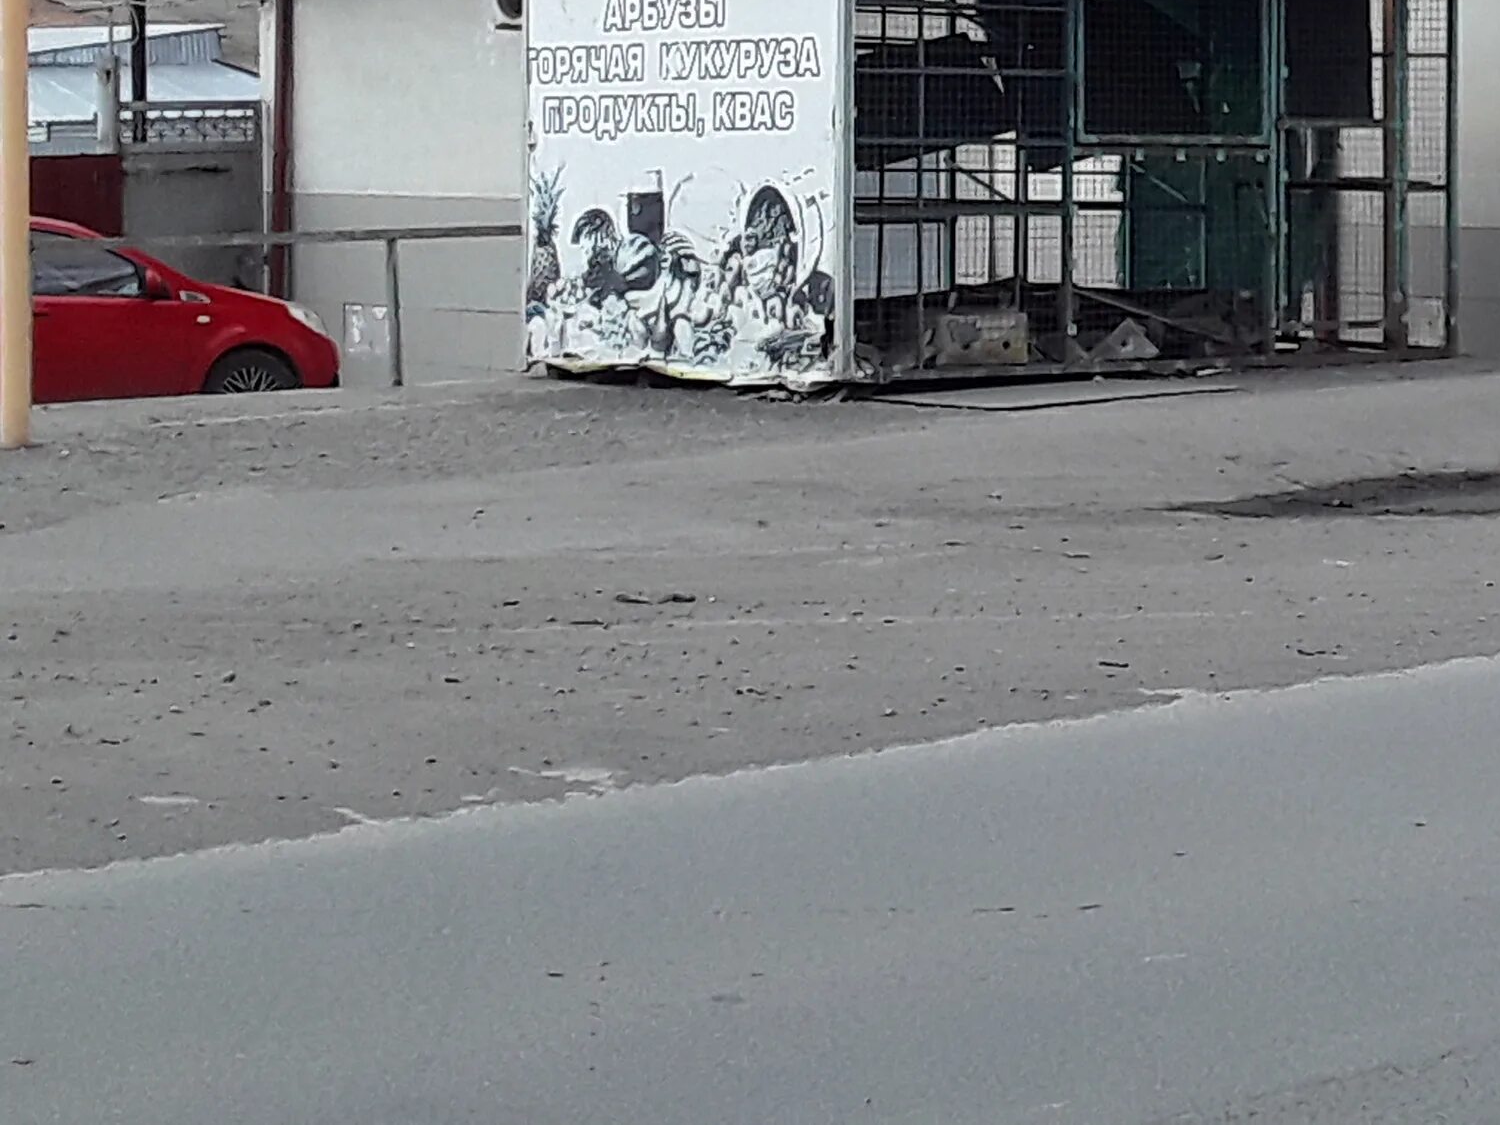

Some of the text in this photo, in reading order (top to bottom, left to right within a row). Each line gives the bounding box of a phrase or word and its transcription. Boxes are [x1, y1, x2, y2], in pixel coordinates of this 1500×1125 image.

[529, 36, 821, 84] ГОРЯЧАЯ КУКУРУЗА
[543, 90, 794, 140] ПРОДУКТЫ, КВАС
